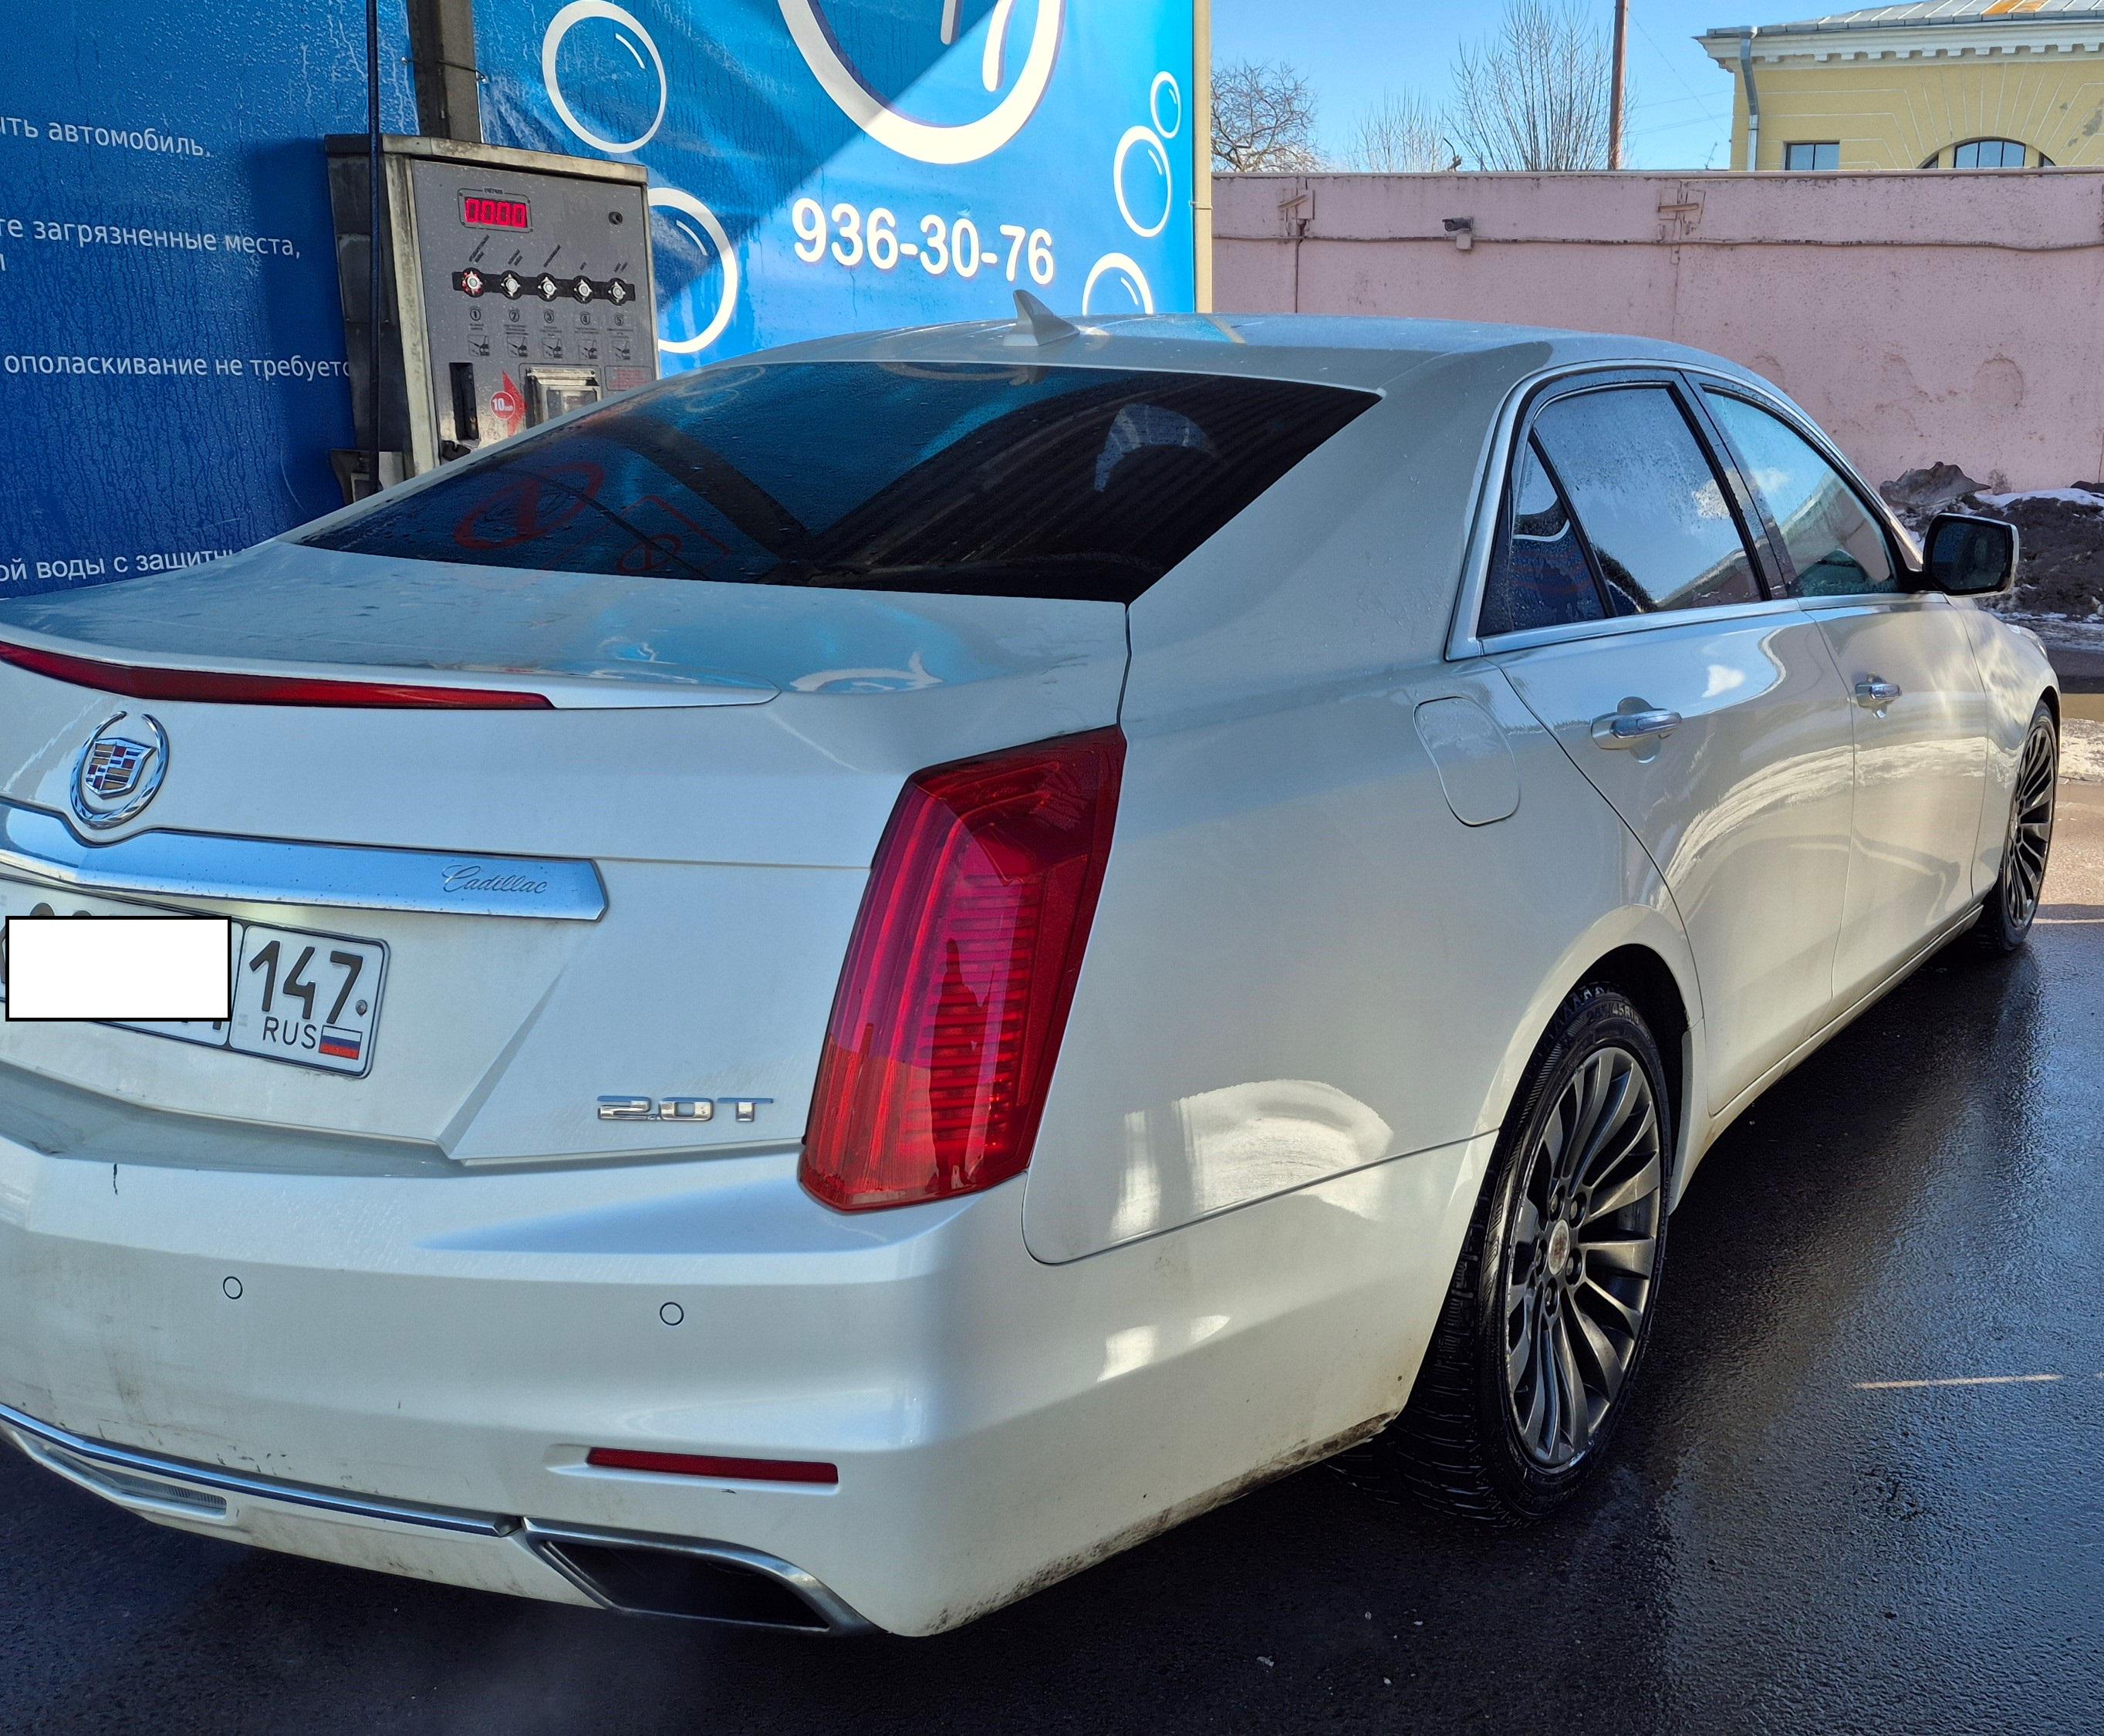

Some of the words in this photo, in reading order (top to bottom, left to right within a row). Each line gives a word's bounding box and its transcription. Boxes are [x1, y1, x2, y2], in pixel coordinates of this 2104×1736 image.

[49, 122, 210, 157] автомобиль.
[466, 198, 526, 228] 0000
[33, 221, 217, 251] загрязненные
[225, 235, 300, 259] места,
[791, 198, 1054, 285] 936-30-76
[4, 355, 208, 375] ополаскивание
[215, 359, 244, 377] не
[492, 397, 505, 411] 10
[36, 558, 106, 581] воды
[113, 556, 129, 573] с
[135, 549, 245, 572] защитн
[441, 864, 548, 894] Cadillac
[248, 940, 364, 1025] 147
[262, 1016, 317, 1049] RUS
